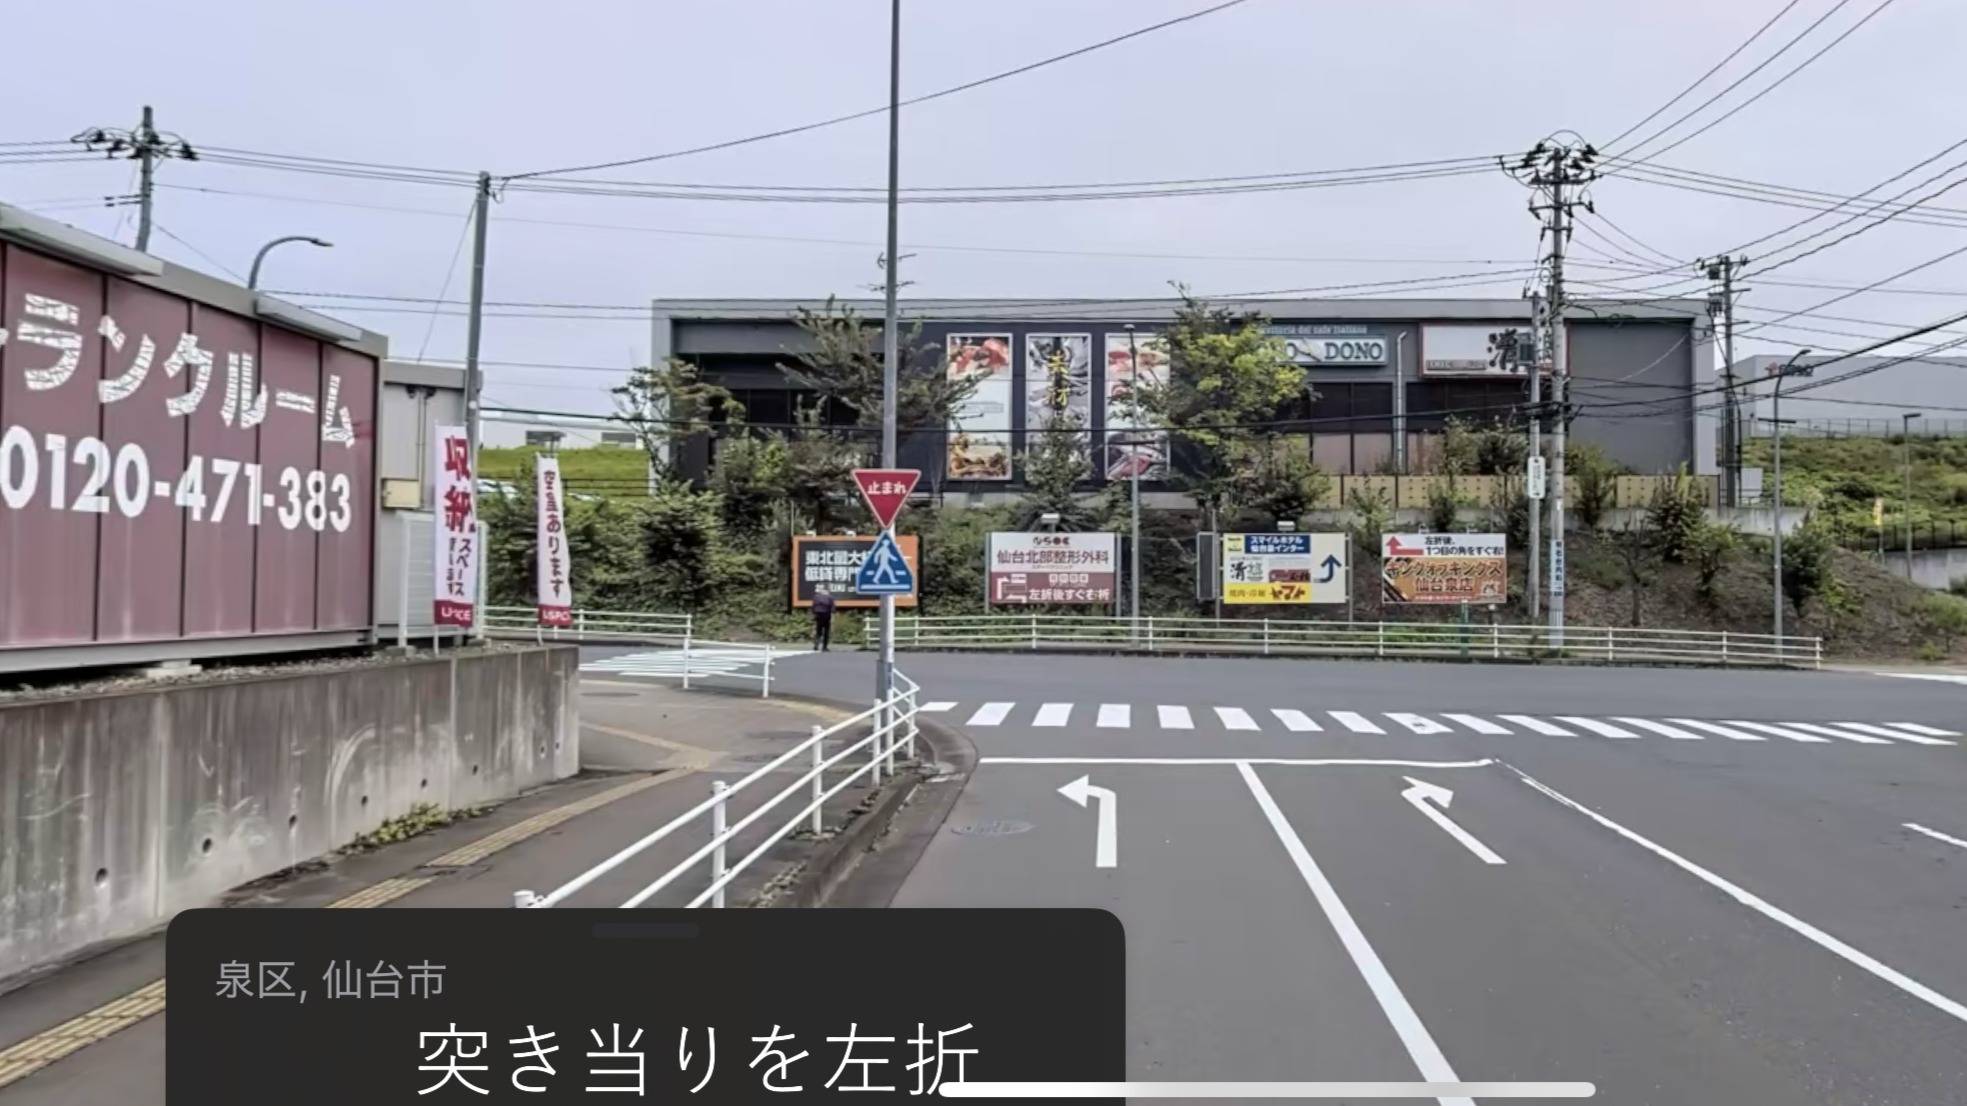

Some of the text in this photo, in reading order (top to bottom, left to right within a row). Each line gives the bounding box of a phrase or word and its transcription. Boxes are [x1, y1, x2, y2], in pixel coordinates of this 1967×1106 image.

[1324, 341, 1383, 360] DONO
[0, 293, 355, 447] ランクルーム
[0, 425, 351, 532] 0120-471-383
[867, 481, 906, 495] 止まれ
[1250, 536, 1303, 544] スマイルホテル
[997, 549, 1109, 564] 仙台北部整形外科
[1028, 588, 1110, 601] 左折後すぐ右折
